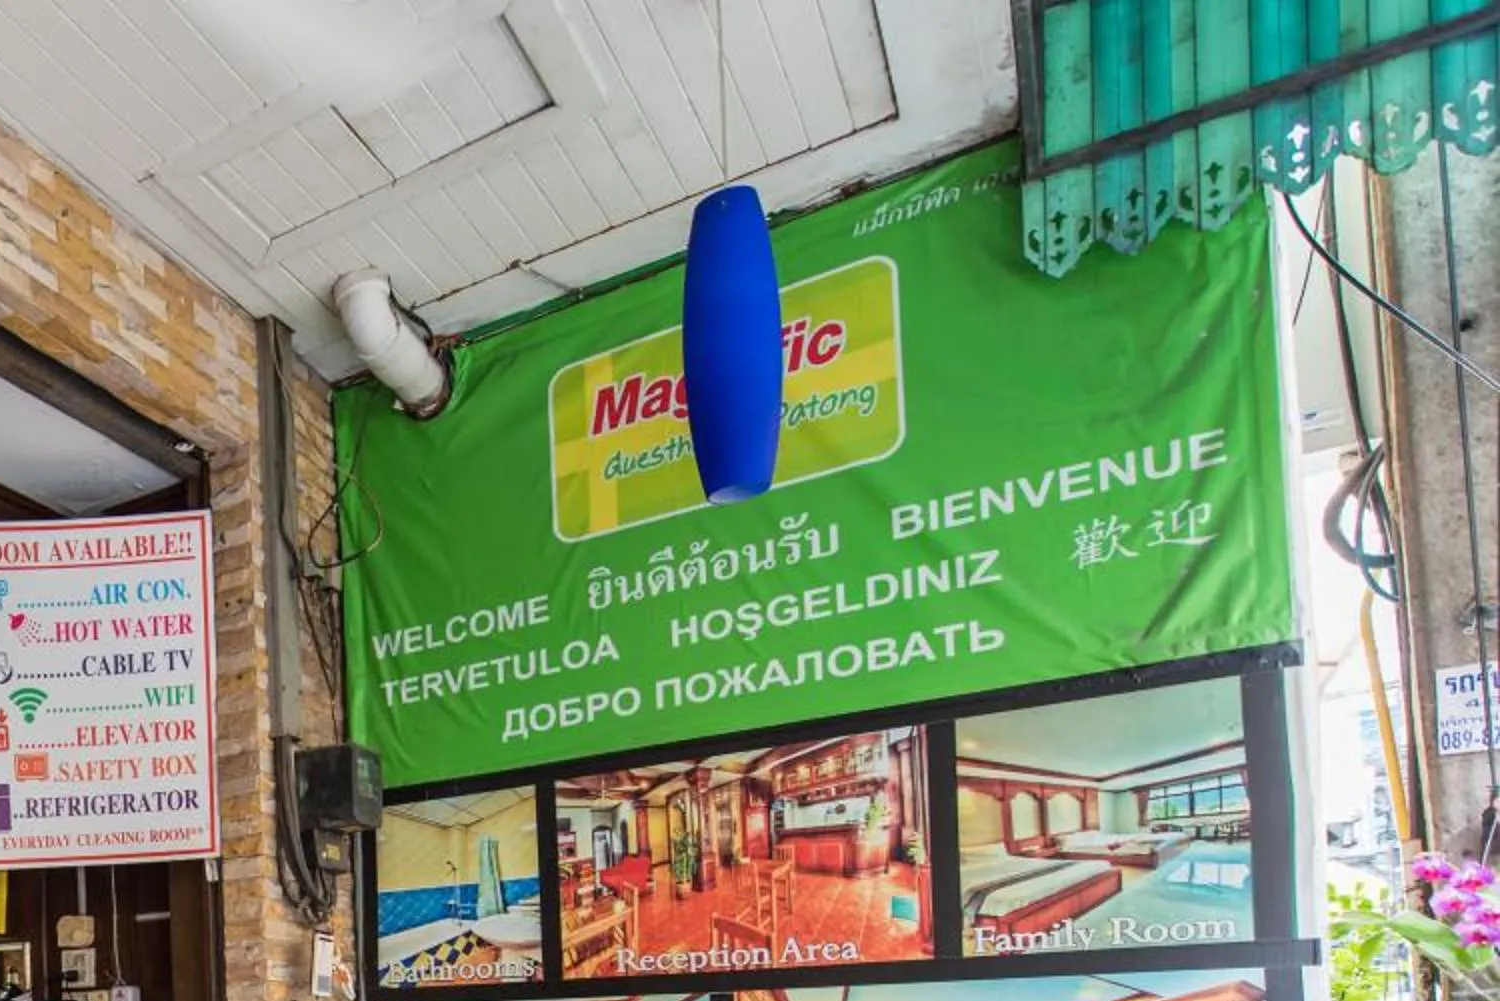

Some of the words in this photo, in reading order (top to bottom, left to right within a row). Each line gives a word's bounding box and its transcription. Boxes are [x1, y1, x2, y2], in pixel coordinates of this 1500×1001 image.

[891, 429, 1228, 540] BIENVENUE
[50, 532, 192, 562] AVAILABLE!!
[587, 512, 840, 610] ยินดีต้อนรับ
[671, 549, 1004, 648] HOŞGELDINIZ
[112, 613, 194, 639] WATER
[371, 595, 551, 661] WELCOME
[164, 649, 194, 671] TV
[380, 634, 620, 708] TERVETULOA
[144, 684, 197, 708] WIFI
[501, 687, 642, 743] ДОБРО
[655, 619, 1006, 710] ПОЖАЛОВАТЬ
[151, 754, 198, 778] BOX
[3, 833, 71, 850] EVERYDAY
[77, 830, 145, 847] CLEANING
[972, 918, 1096, 955] Family
[1110, 915, 1237, 946] Room
[388, 957, 536, 985] Bathrooms
[616, 941, 772, 975] Reception
[779, 936, 859, 966] Area
